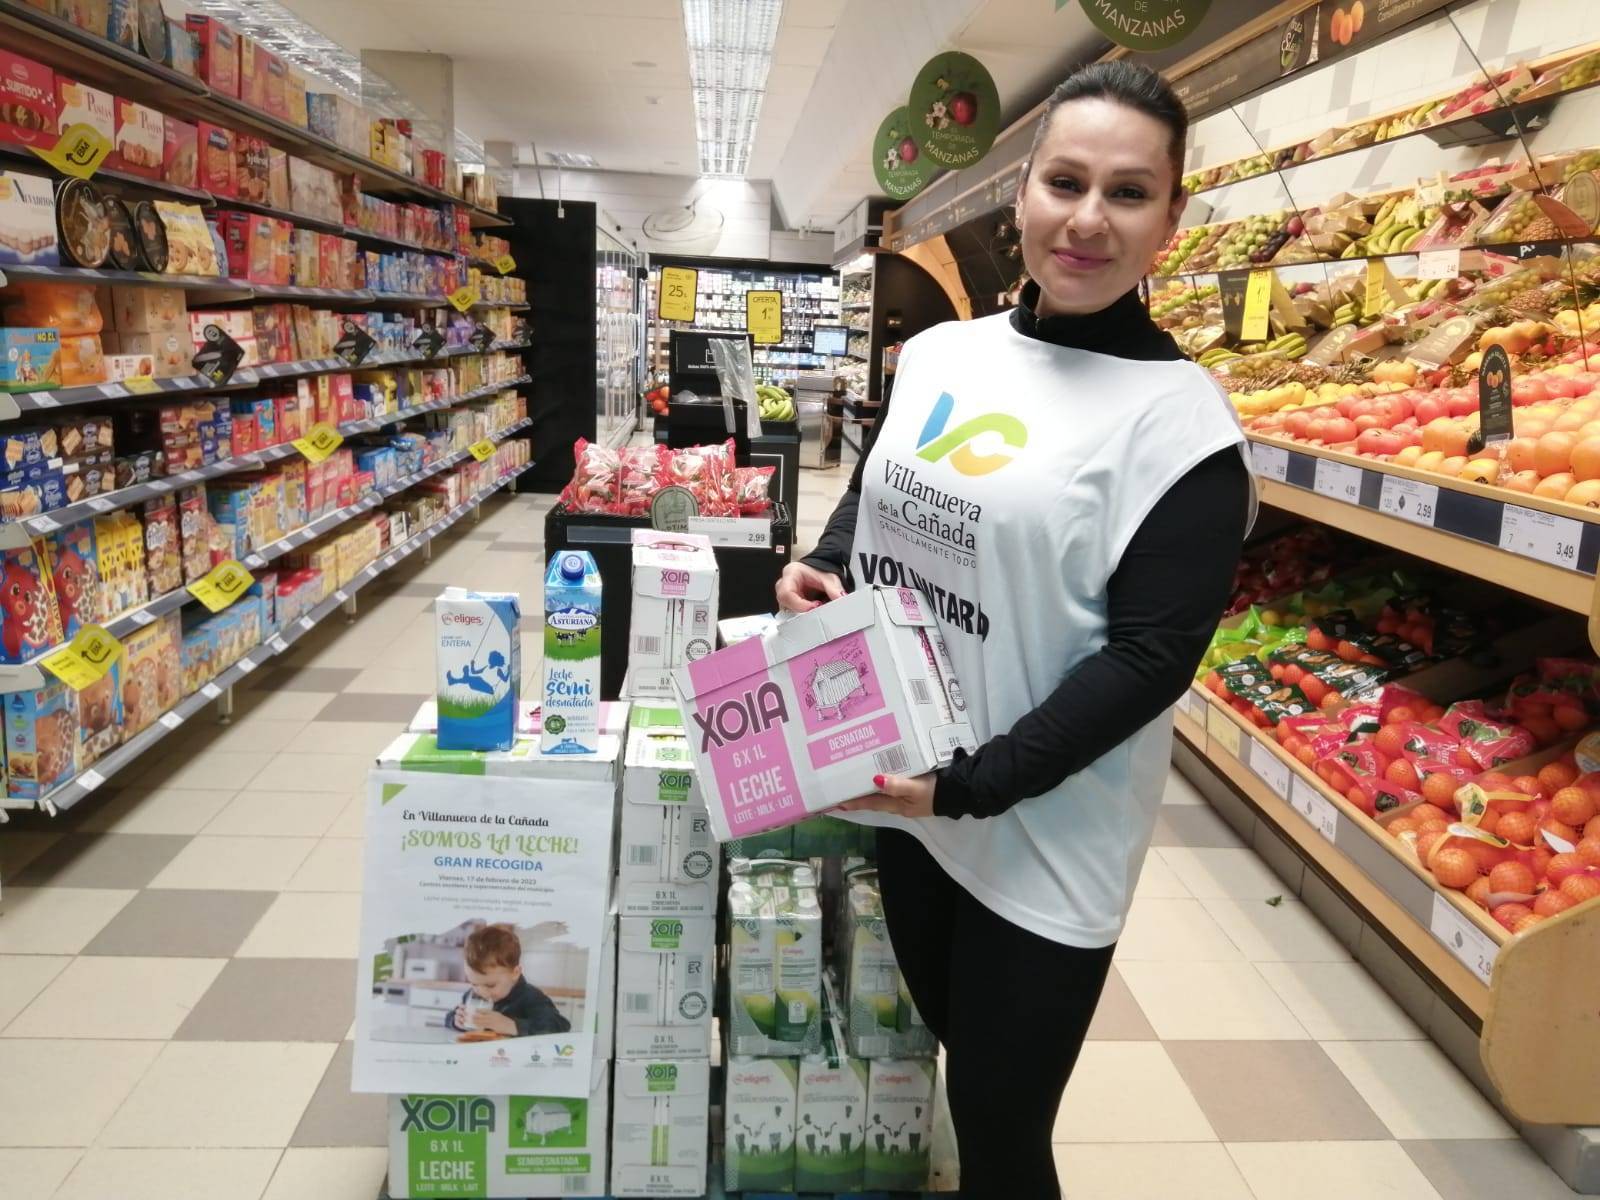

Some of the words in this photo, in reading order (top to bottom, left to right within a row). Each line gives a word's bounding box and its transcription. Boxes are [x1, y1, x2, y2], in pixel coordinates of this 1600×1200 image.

[1095, 0, 1186, 37] MANZANAS
[924, 140, 979, 163] MANZANAS
[885, 177, 922, 195] MANZANAS
[883, 459, 982, 523] Villanueva
[1416, 502, 1432, 519] 2,59
[878, 498, 888, 513] de
[890, 503, 899, 518] la
[902, 500, 976, 551] Cañada
[747, 533, 766, 543] 2,99
[880, 520, 949, 559] SENCILLAMENTE
[953, 553, 977, 569] TODO
[1556, 542, 1574, 559] 3,49
[661, 570, 691, 585] XOIA
[454, 613, 483, 626] eliges
[550, 615, 594, 626] ASTURIANA
[441, 640, 472, 648] ENTERA
[691, 681, 790, 754] XOIA
[828, 724, 876, 751] DESNATADA
[732, 751, 741, 768] 6
[742, 748, 752, 765] X
[752, 743, 767, 761] 1L
[658, 774, 692, 789] XOIA
[729, 765, 787, 808] LECHE
[402, 809, 416, 821] En
[419, 809, 477, 824] Villanueva
[480, 812, 492, 824] de
[494, 814, 506, 825] la
[508, 814, 549, 827] Cañada
[486, 832, 511, 855] LA
[434, 856, 472, 868] GRAN
[475, 858, 543, 872] RECOGIDA
[650, 922, 683, 937] XOIA
[645, 1065, 678, 1080] XOIA
[400, 1098, 497, 1133] XOIA
[430, 1140, 439, 1153] 6
[440, 1140, 450, 1153] X
[452, 1140, 464, 1153] 1L
[420, 1161, 476, 1181] LECHE
